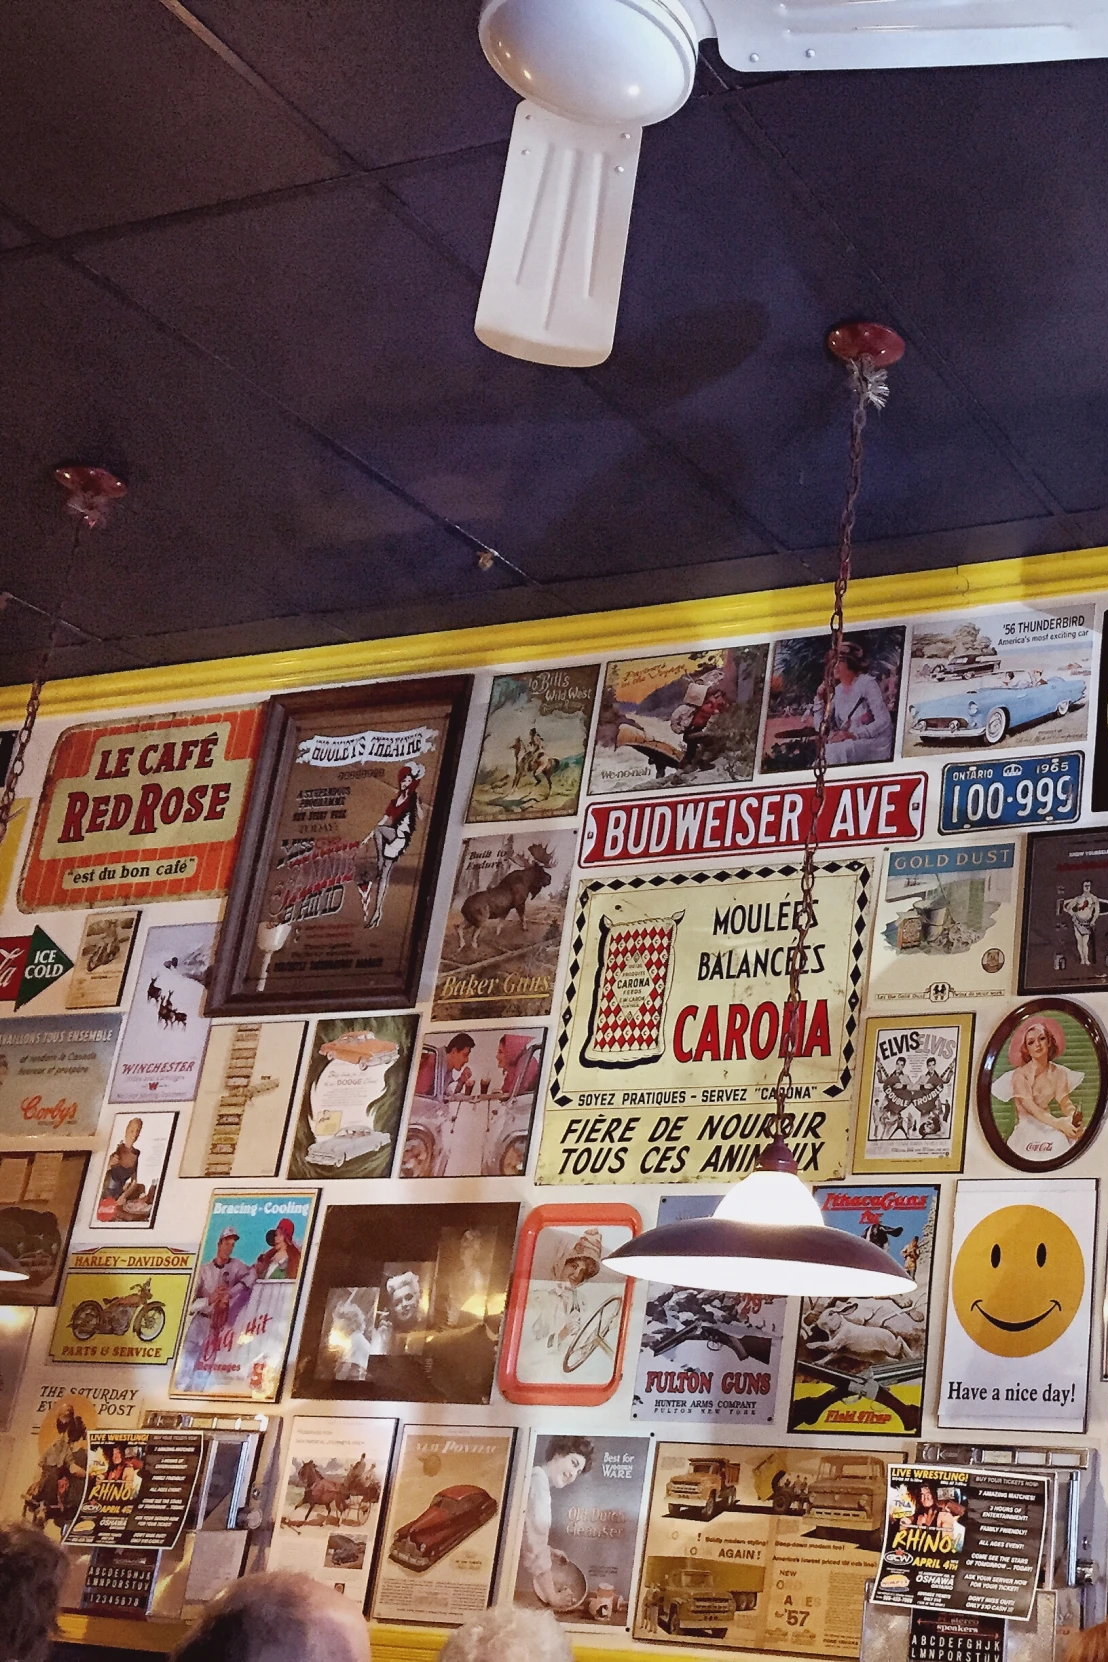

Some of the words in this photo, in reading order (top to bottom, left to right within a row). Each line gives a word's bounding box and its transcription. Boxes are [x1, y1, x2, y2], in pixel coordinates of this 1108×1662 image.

[1002, 623, 1017, 636] '56
[1017, 614, 1086, 635] THUNDERBIRD
[1049, 631, 1077, 644] exciting
[567, 686, 592, 700] West
[95, 745, 131, 782] LE
[137, 731, 219, 775] CAFÉ
[952, 768, 994, 781] ONTARIO
[1036, 761, 1070, 774] 1965
[57, 791, 131, 844] RED
[129, 783, 231, 836] ROSE
[603, 792, 803, 857] BUDWEISER
[829, 783, 900, 840] AVE
[894, 854, 950, 871] GOLD
[956, 849, 1011, 865] DUST
[98, 866, 117, 881] du
[120, 863, 150, 879] bon
[34, 949, 56, 964] ICE
[24, 964, 64, 980] COLD
[441, 975, 500, 997] Baker
[502, 972, 549, 993] Guns
[67, 1029, 113, 1043] ENSEMBLE
[878, 1030, 922, 1061] ELVIS
[917, 1033, 956, 1060] ELVIS
[121, 1060, 196, 1076] WINCHESTER
[577, 1091, 614, 1107] SOYEZ
[622, 1089, 686, 1106] PRATIQUES
[701, 1087, 748, 1103] SERVEZ
[885, 1087, 910, 1107] DOUBLE
[912, 1085, 944, 1107] TROUBLE
[560, 1112, 641, 1144] FIÈRE
[650, 1114, 688, 1142] DE
[559, 1146, 627, 1175] TOUS
[649, 1144, 690, 1174] CES
[61, 1346, 97, 1357] PARTS
[113, 1347, 162, 1358] SERVICE
[644, 1370, 713, 1394] FULTON
[720, 1372, 772, 1395] GUNS
[39, 1386, 66, 1398] THE
[947, 1381, 988, 1402] Have
[991, 1388, 1001, 1401] a
[1004, 1382, 1038, 1402] nice
[1042, 1383, 1076, 1405] day!
[99, 1403, 136, 1418] POST
[654, 1399, 689, 1408] HUNTER
[690, 1399, 713, 1408] ARMS
[717, 1400, 757, 1409] COMPANY
[603, 1451, 622, 1464] Best
[622, 1451, 634, 1464] for
[891, 1468, 912, 1478] LIVE
[913, 1469, 969, 1482] WRESTLING!
[568, 1507, 588, 1522] Old
[591, 1506, 625, 1522] Dutch
[565, 1521, 625, 1539] Cleanser
[892, 1530, 962, 1554] RHINO!
[912, 1556, 941, 1569] APRIL
[915, 1575, 954, 1586] OSHAWA
[784, 1608, 810, 1627] '57
[936, 1624, 979, 1633] speakers
